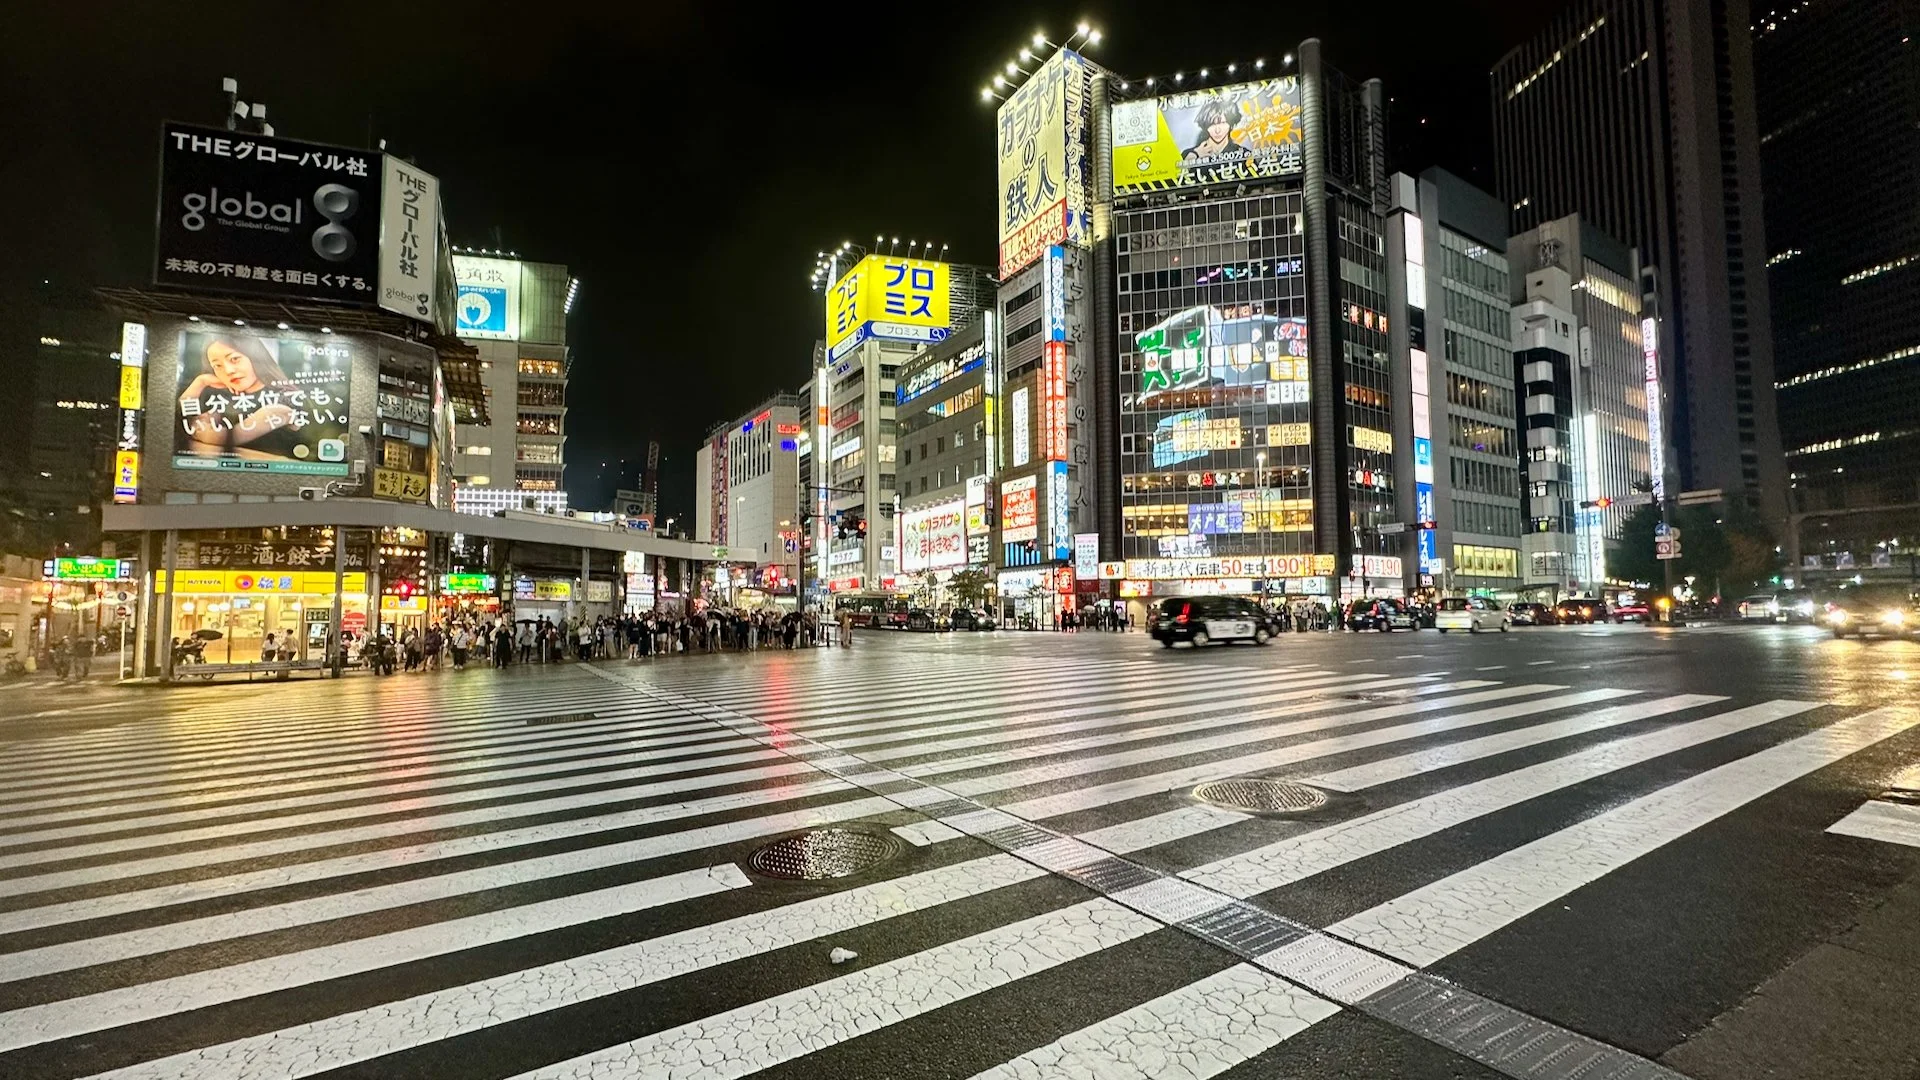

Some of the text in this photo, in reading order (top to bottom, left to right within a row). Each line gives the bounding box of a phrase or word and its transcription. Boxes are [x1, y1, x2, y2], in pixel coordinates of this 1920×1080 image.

[1000, 60, 1062, 163] カラオケ
[171, 132, 368, 177] THEグローバル社
[1024, 134, 1037, 170] の
[1065, 55, 1086, 240] カラオケの鉄人
[396, 169, 427, 193] THE
[1178, 154, 1303, 186] たいせい先生
[1005, 154, 1058, 234] 鉄人
[183, 187, 301, 232] global
[217, 217, 290, 233] The Global Group
[399, 189, 420, 280] グローバル社
[165, 257, 373, 292] 未来の不動産を面白くする。
[885, 264, 934, 291] プロ
[838, 274, 859, 309] プロ
[885, 292, 933, 318] ミス
[838, 304, 859, 334] ミス
[886, 326, 920, 337] プロミス
[306, 346, 349, 358] paters
[180, 387, 344, 418] 自分本位でも、
[182, 408, 347, 436] いいじゃない。
[924, 513, 955, 532] カラオケ
[1190, 512, 1228, 533] 大戸屋
[235, 544, 253, 555] 2F
[252, 546, 335, 566] 酒と餃子
[834, 551, 854, 563] カラオケ
[919, 534, 960, 559] まねきねこ
[59, 560, 116, 575] 思い出横丁
[1144, 559, 1192, 577] 新時代
[258, 577, 292, 589] 松屋
